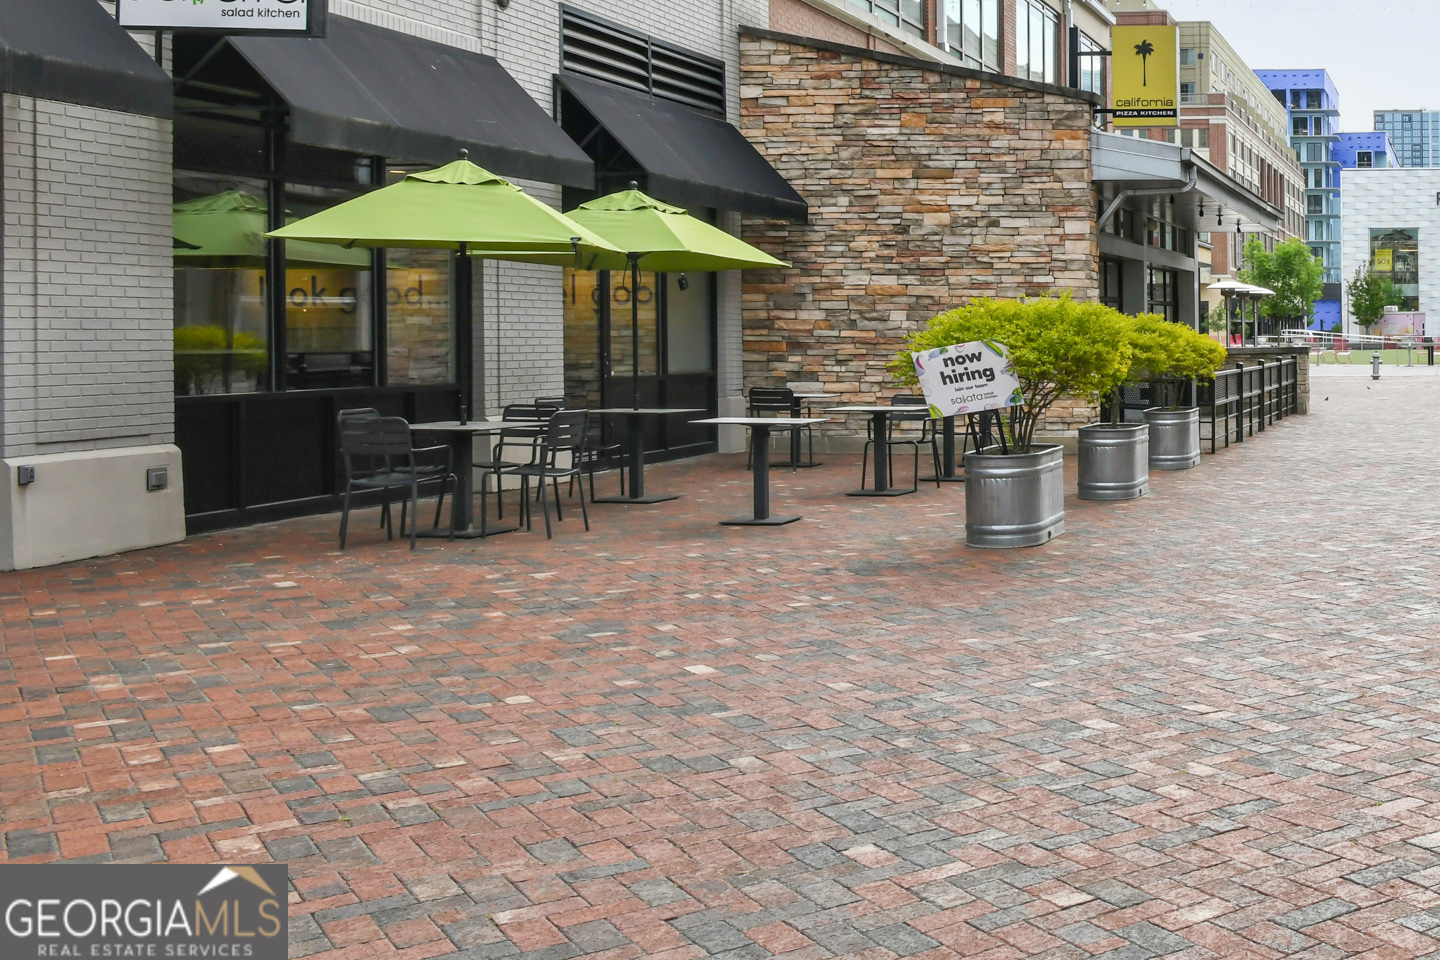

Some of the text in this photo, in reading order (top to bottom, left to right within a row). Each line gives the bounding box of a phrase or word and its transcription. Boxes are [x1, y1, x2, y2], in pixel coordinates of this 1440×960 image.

[221, 7, 301, 18] salad kitchen
[1115, 97, 1174, 107] california
[943, 351, 982, 367] now
[940, 367, 996, 386] hiring
[951, 393, 983, 405] salata
